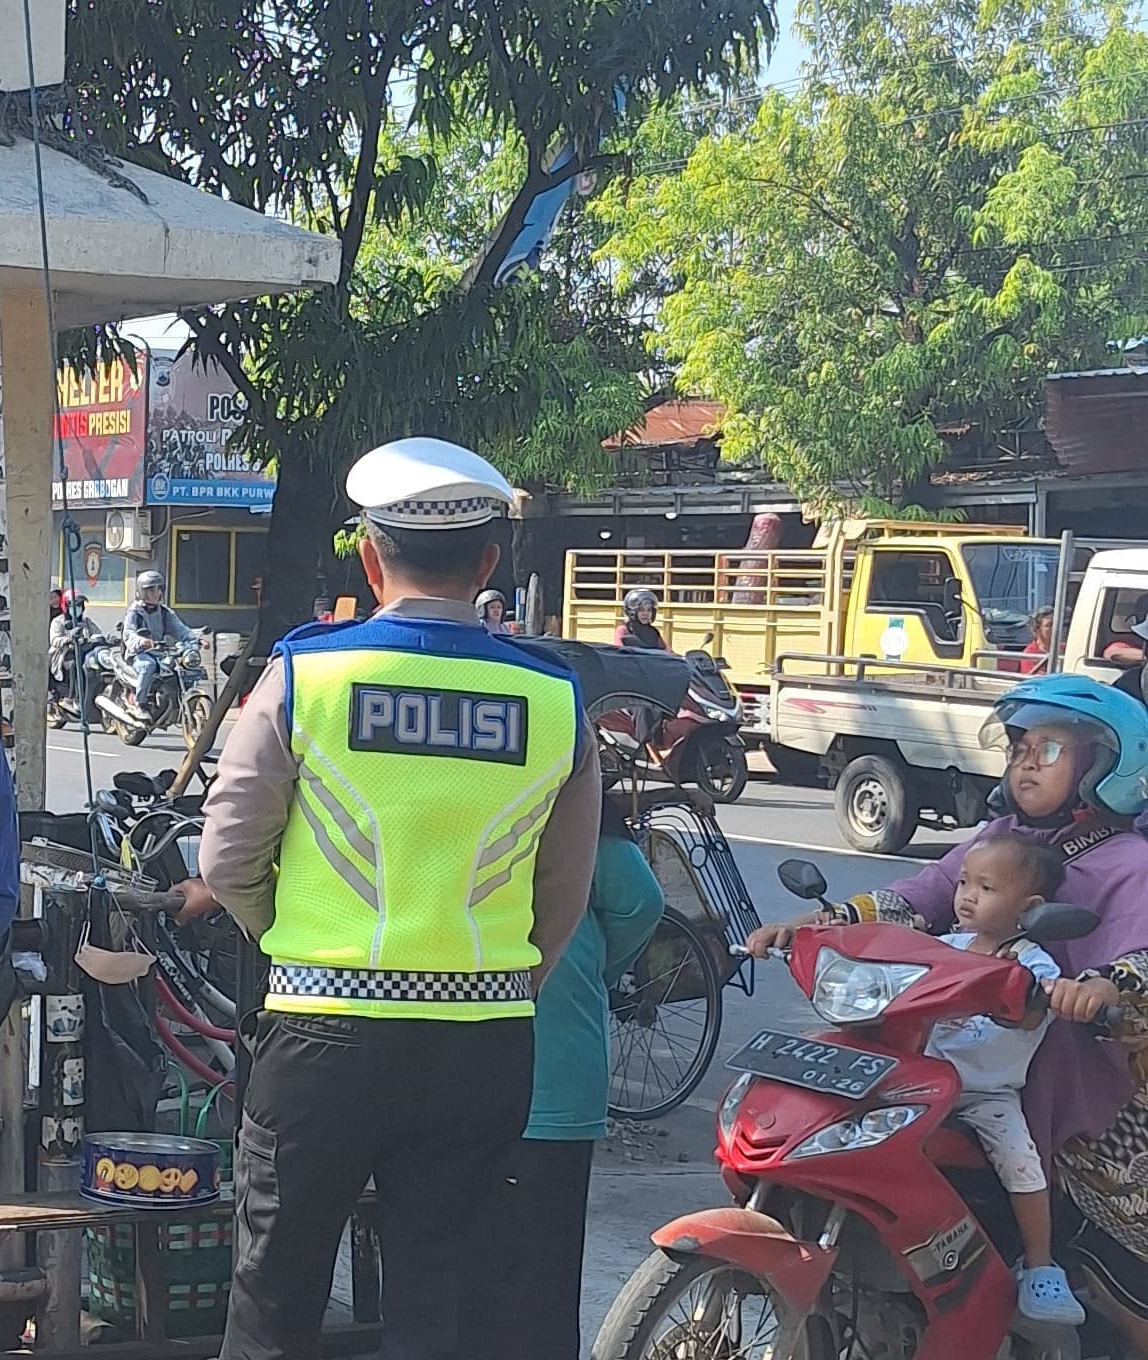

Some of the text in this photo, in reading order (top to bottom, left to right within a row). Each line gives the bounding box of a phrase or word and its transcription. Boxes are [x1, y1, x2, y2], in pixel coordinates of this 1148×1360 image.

[88, 409, 131, 436] PRESISI
[162, 428, 216, 443] PATROLI
[52, 478, 129, 500] PORES GROBOGAN
[172, 486, 189, 497] PT.
[191, 486, 214, 497] BPR
[216, 487, 239, 498] BKK
[357, 689, 521, 753] POLISI
[750, 1034, 885, 1076] H 2422 FS
